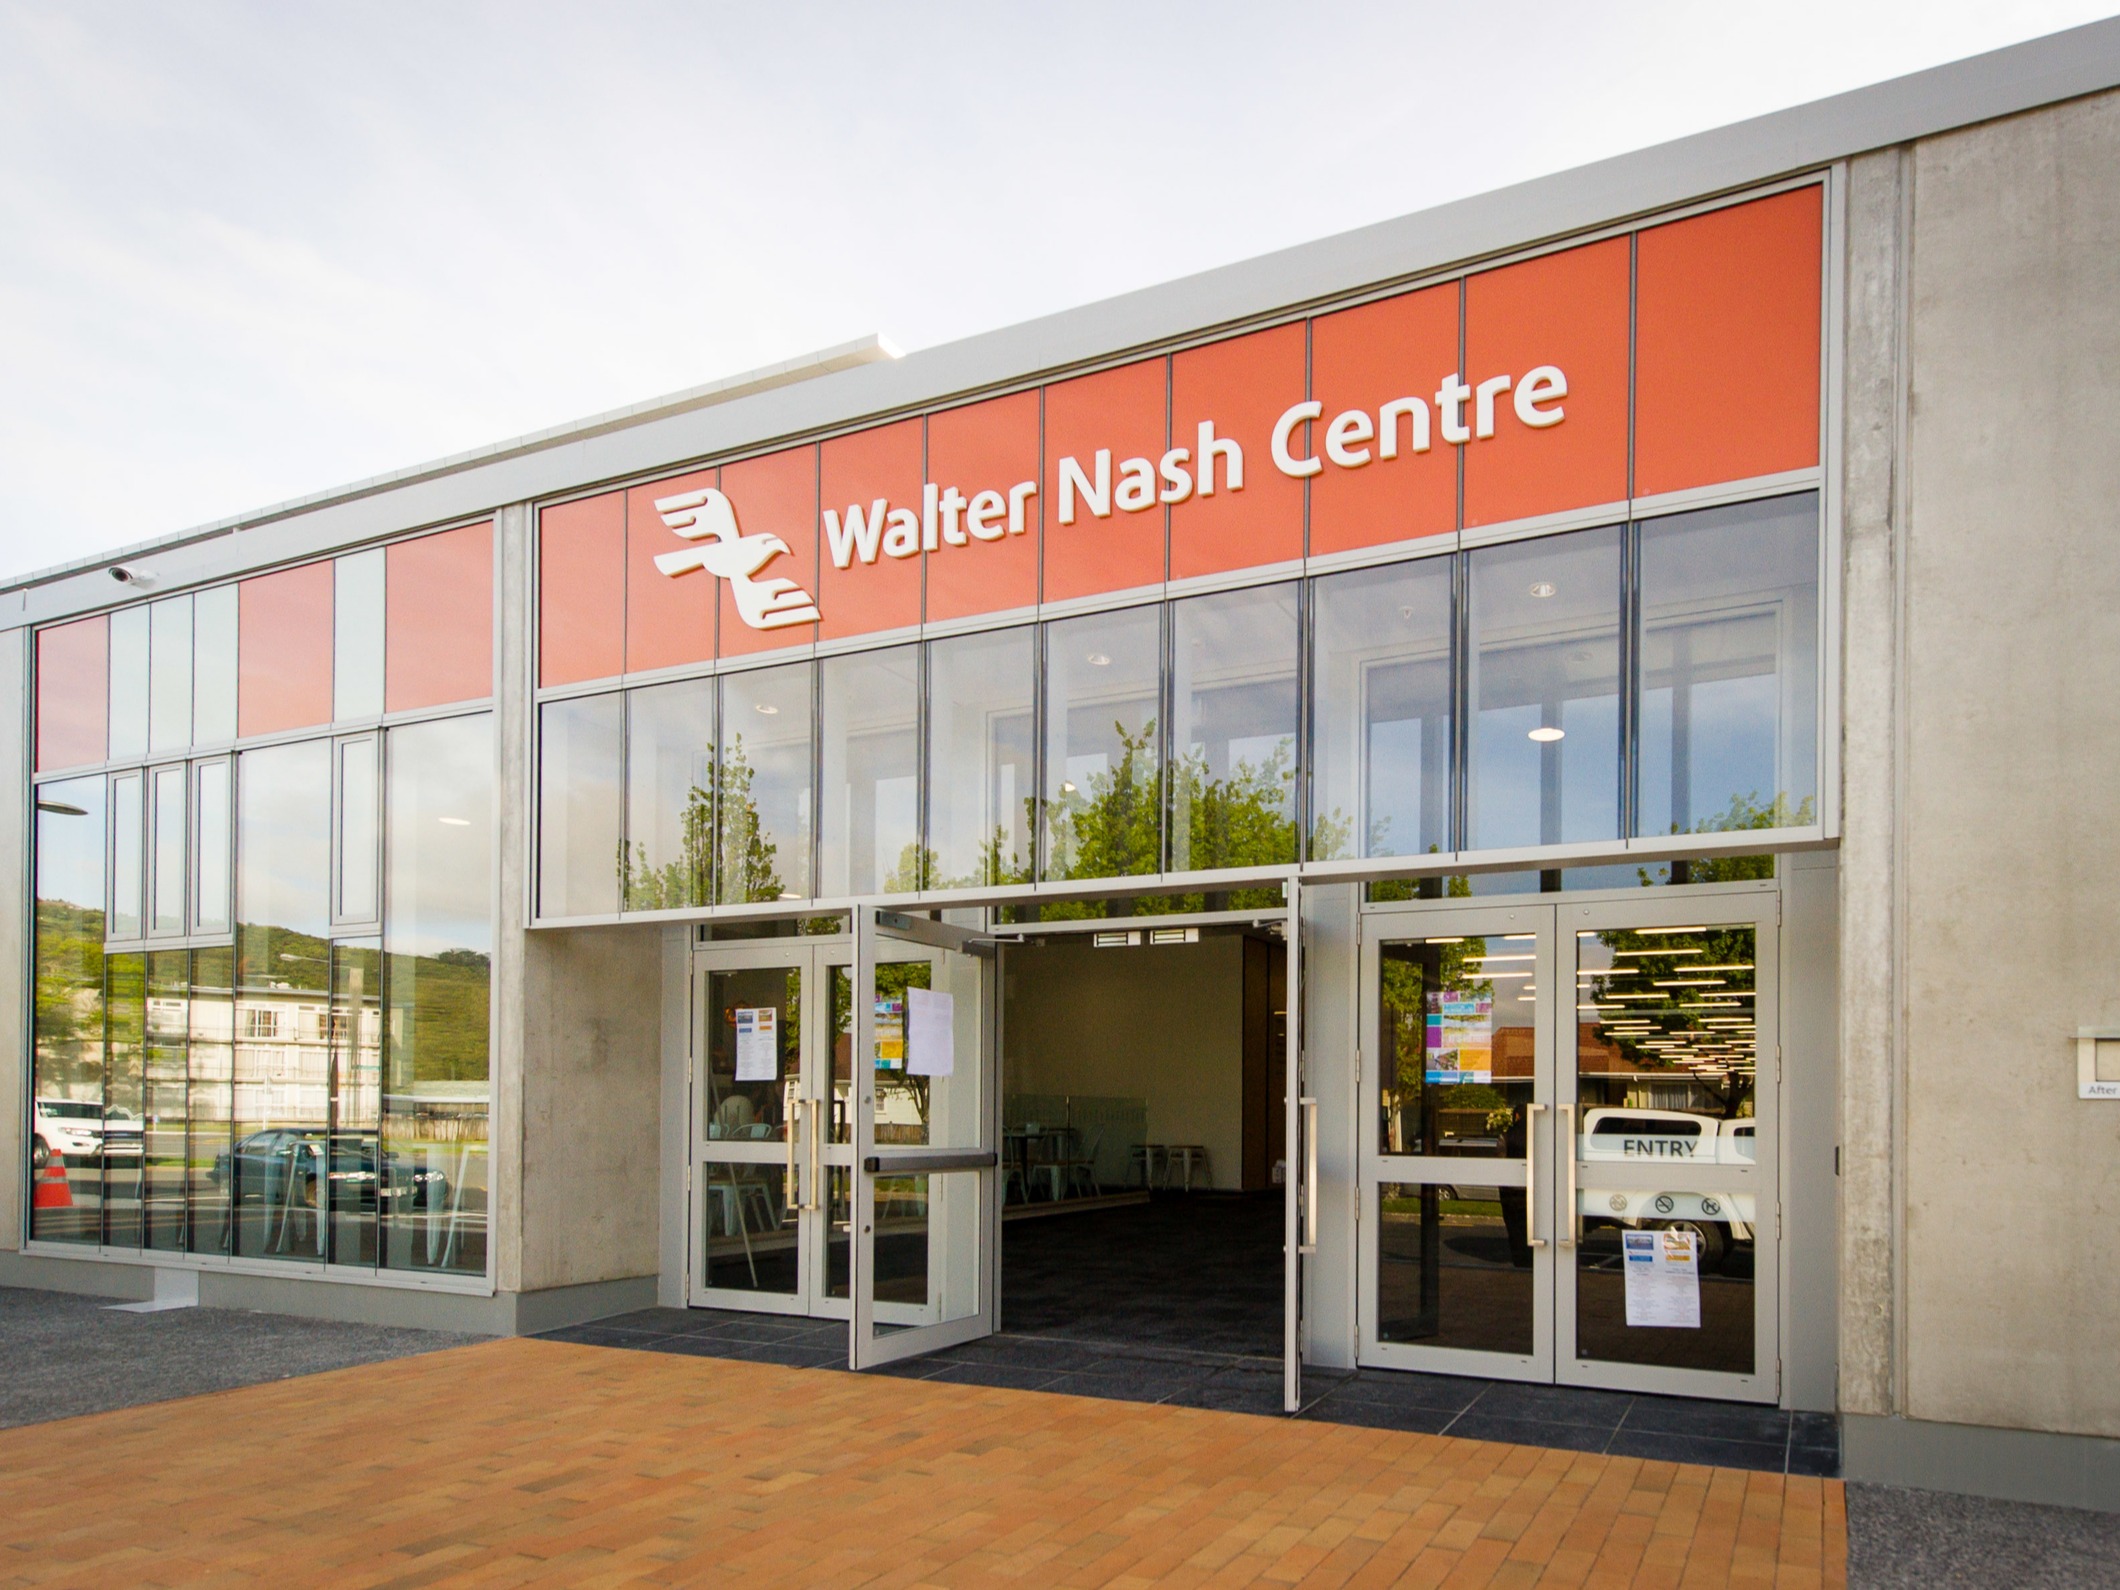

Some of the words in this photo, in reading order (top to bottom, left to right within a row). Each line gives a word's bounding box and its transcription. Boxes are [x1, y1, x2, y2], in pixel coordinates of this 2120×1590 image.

[823, 480, 1037, 569] Walter
[1058, 420, 1244, 525] Nash
[1271, 364, 1569, 478] Centre
[2088, 1085, 2117, 1095] After
[1623, 1139, 1698, 1157] ENTRY
